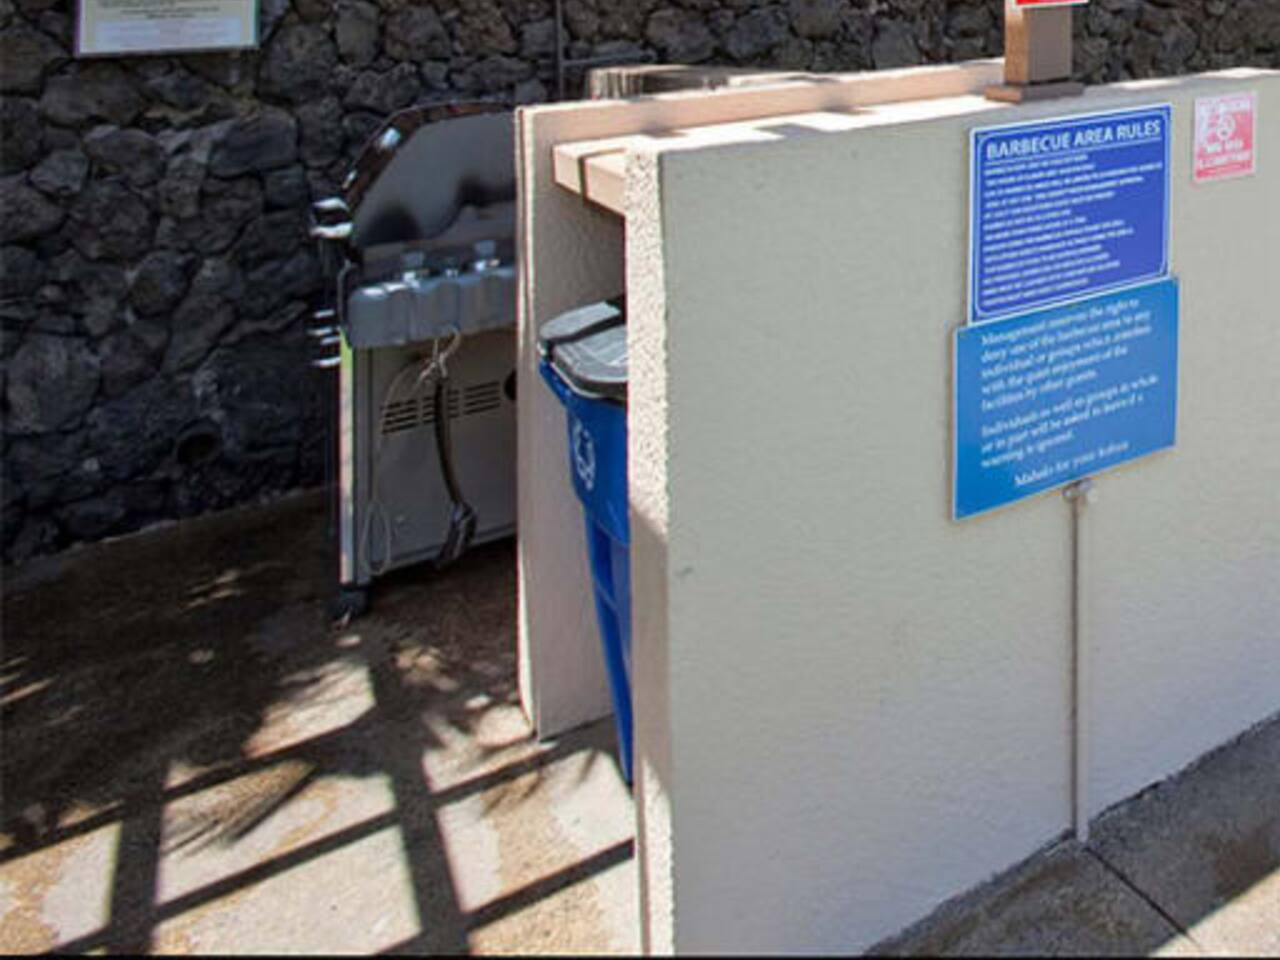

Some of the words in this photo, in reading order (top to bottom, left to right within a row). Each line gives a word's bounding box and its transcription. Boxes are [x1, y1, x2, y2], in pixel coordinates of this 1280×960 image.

[986, 130, 1070, 159] BARBECUE
[1073, 127, 1113, 147] AREA
[1116, 119, 1161, 141] RULES
